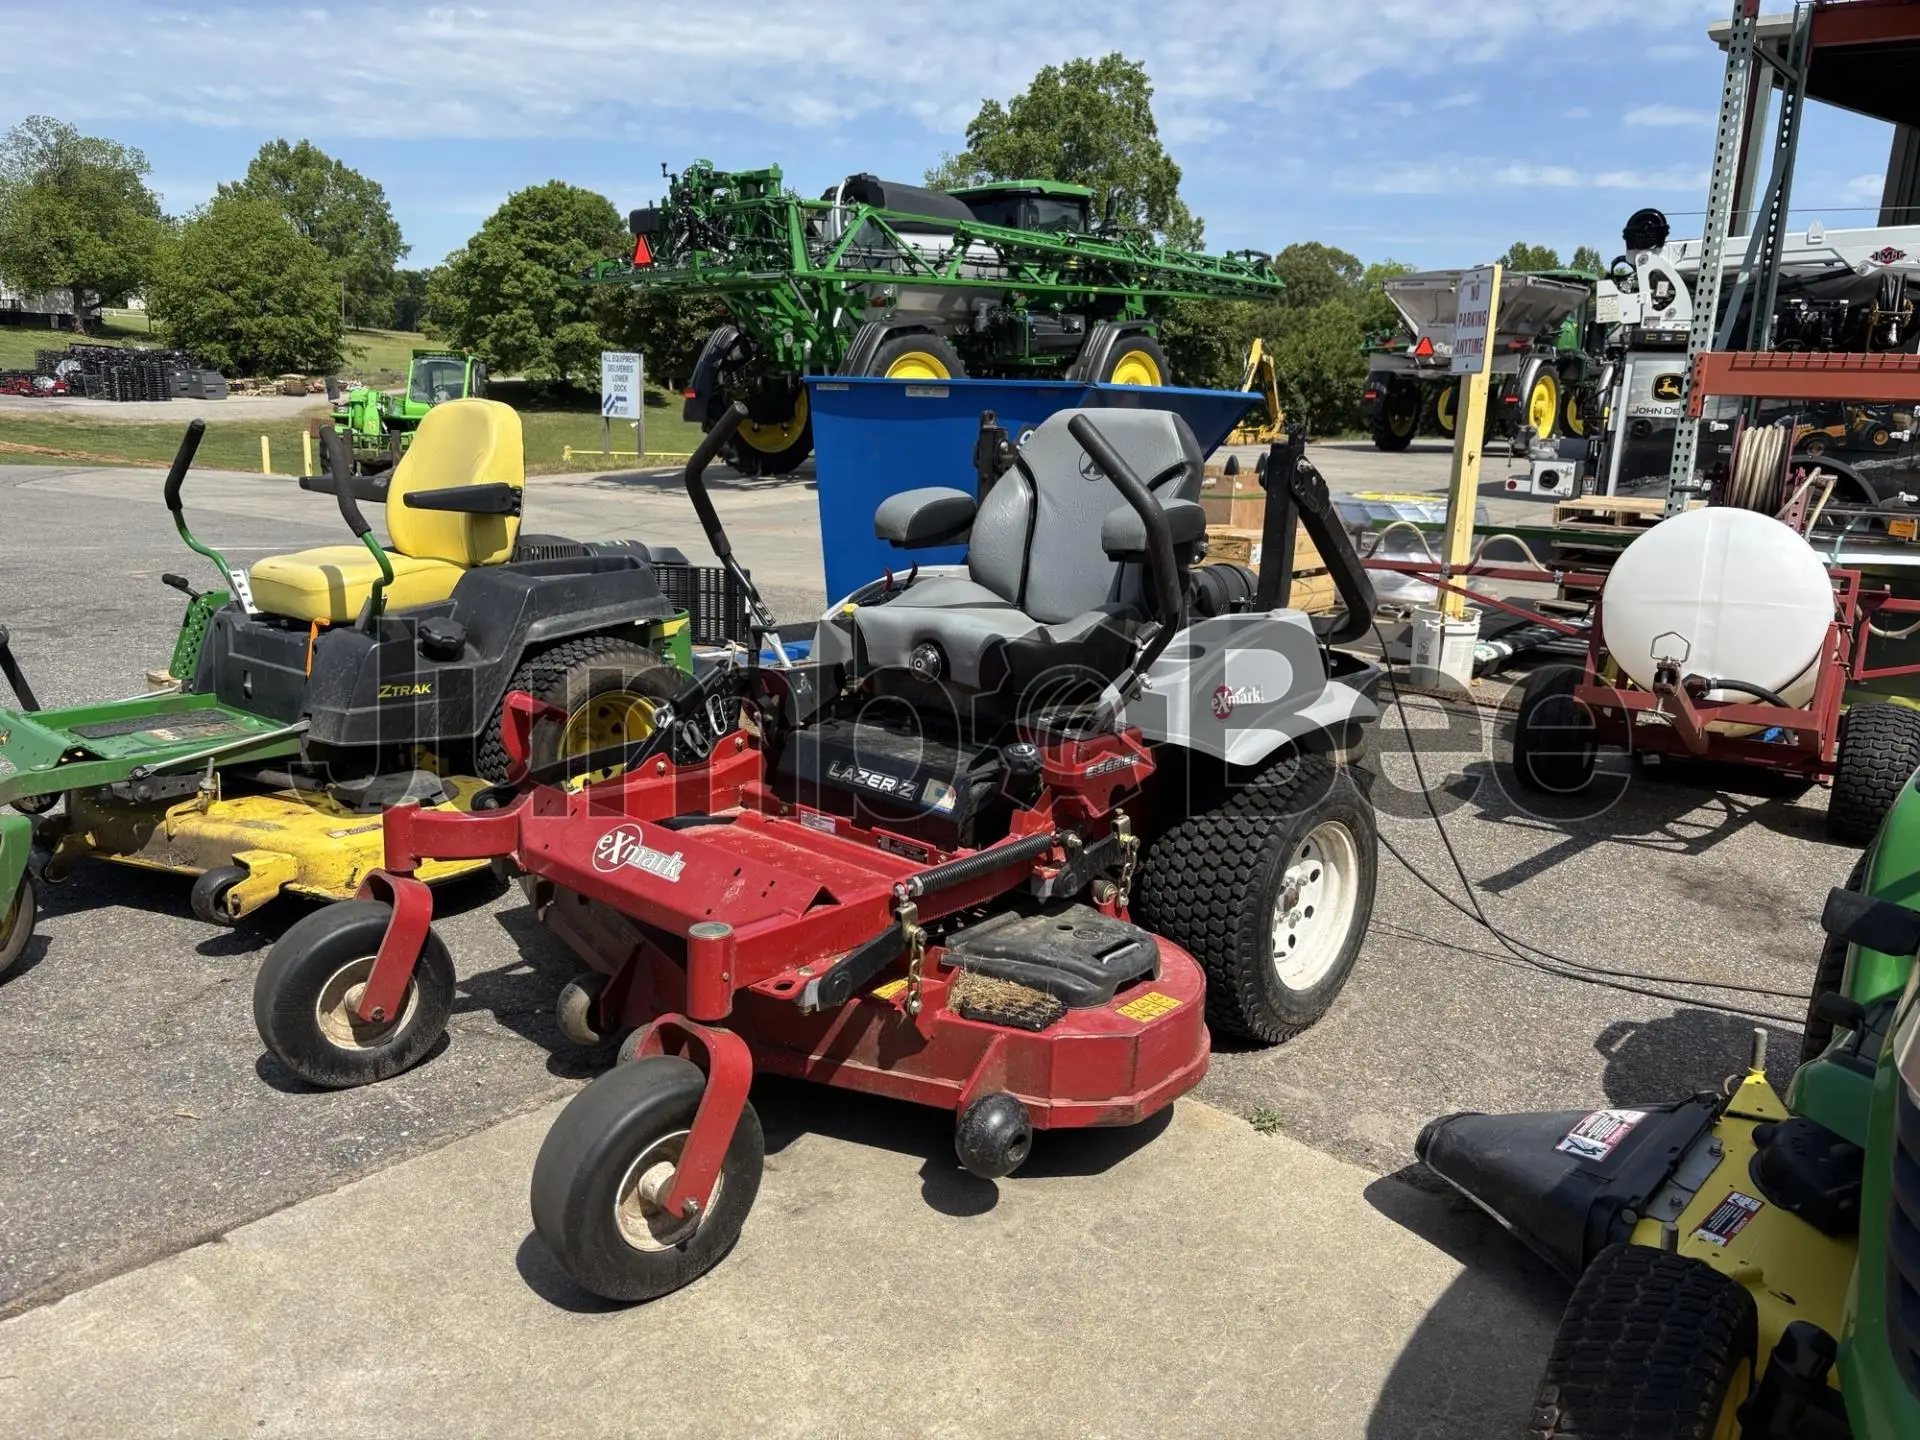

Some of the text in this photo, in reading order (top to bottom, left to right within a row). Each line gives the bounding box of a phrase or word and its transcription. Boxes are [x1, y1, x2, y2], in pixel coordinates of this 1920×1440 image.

[1470, 284, 1480, 301] NO
[1458, 310, 1487, 328] PARKING
[1456, 337, 1484, 354] ANYTIME
[612, 354, 638, 363] EQUIPMENT
[607, 364, 633, 373] DELIVERIES
[612, 374, 629, 382] LOWER
[613, 384, 627, 392] DOCK
[1632, 406, 1661, 415] JOHN
[828, 761, 898, 794] LAZER
[896, 779, 918, 800] Z
